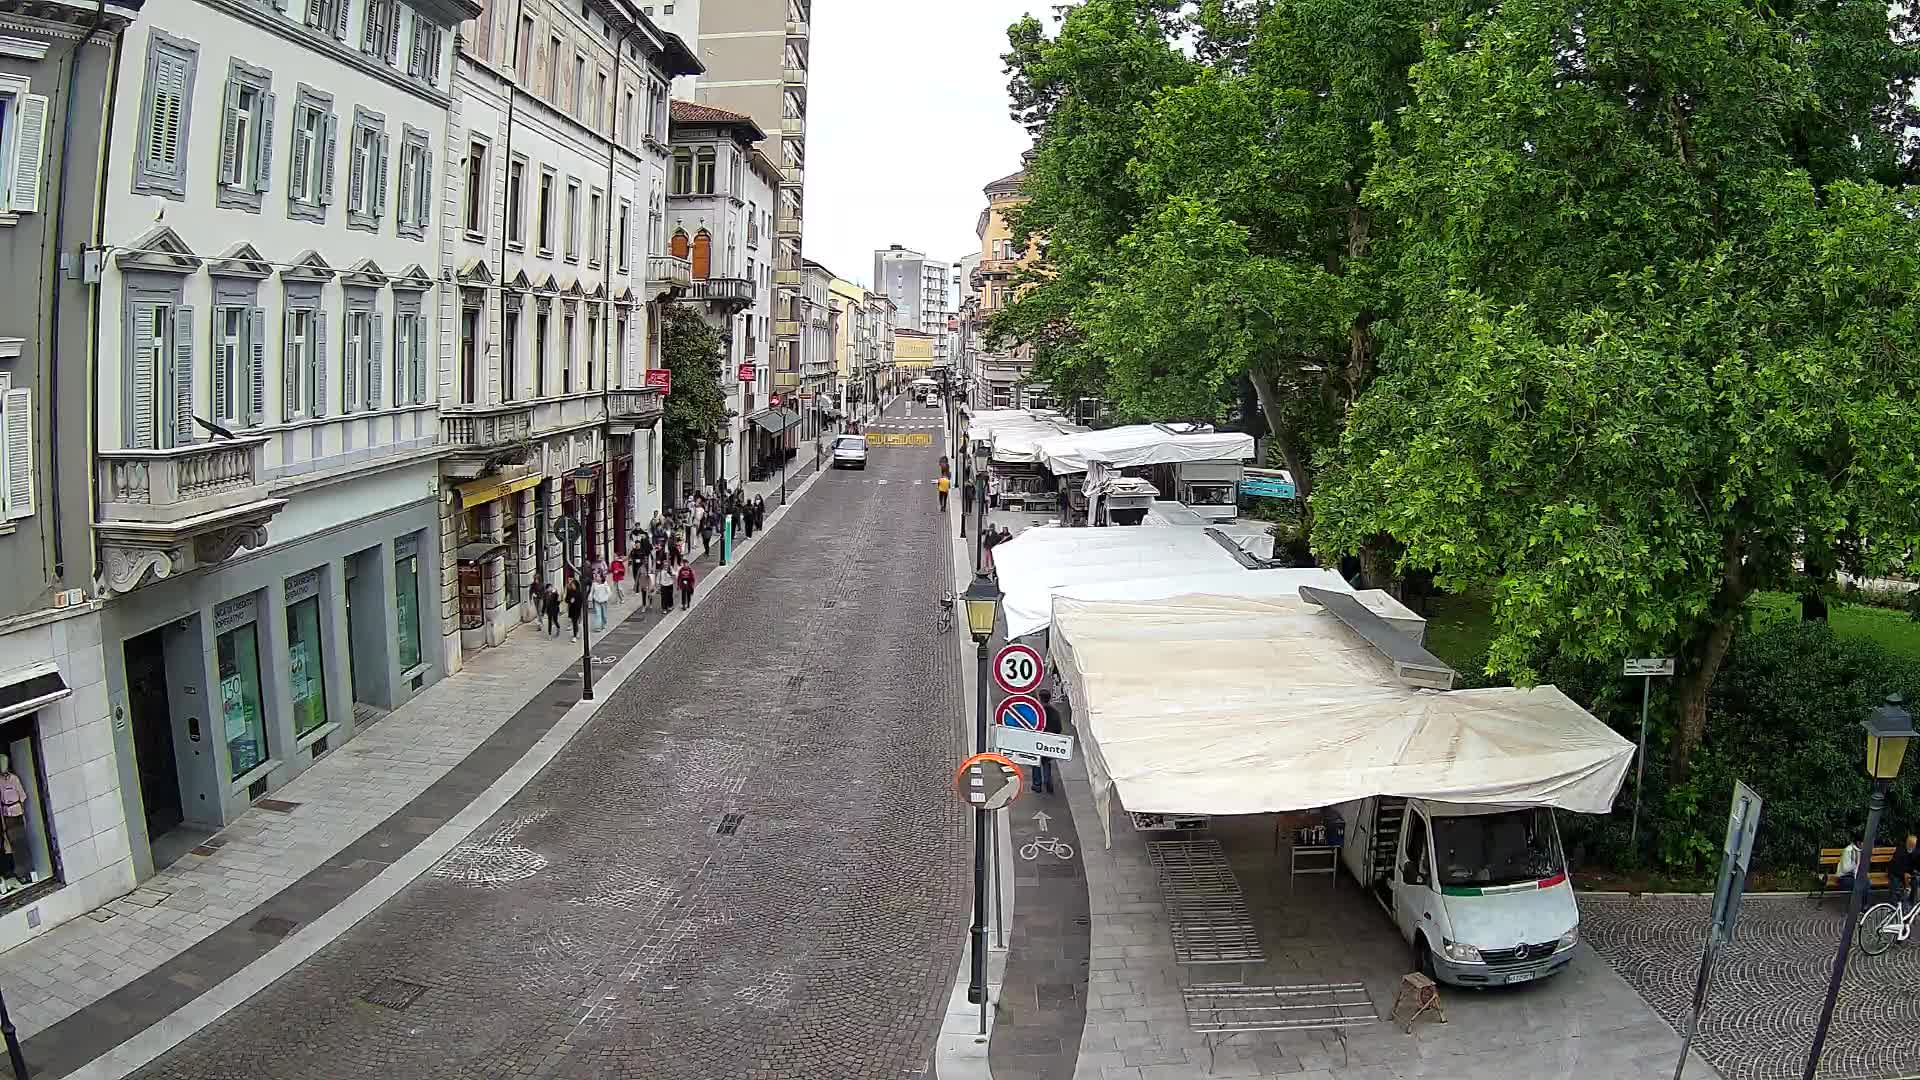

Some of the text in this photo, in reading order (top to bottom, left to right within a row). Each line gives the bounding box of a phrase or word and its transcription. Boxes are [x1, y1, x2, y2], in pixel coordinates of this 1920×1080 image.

[1005, 658, 1033, 680] 30
[222, 677, 241, 700] 130
[1035, 741, 1067, 755] Dante
